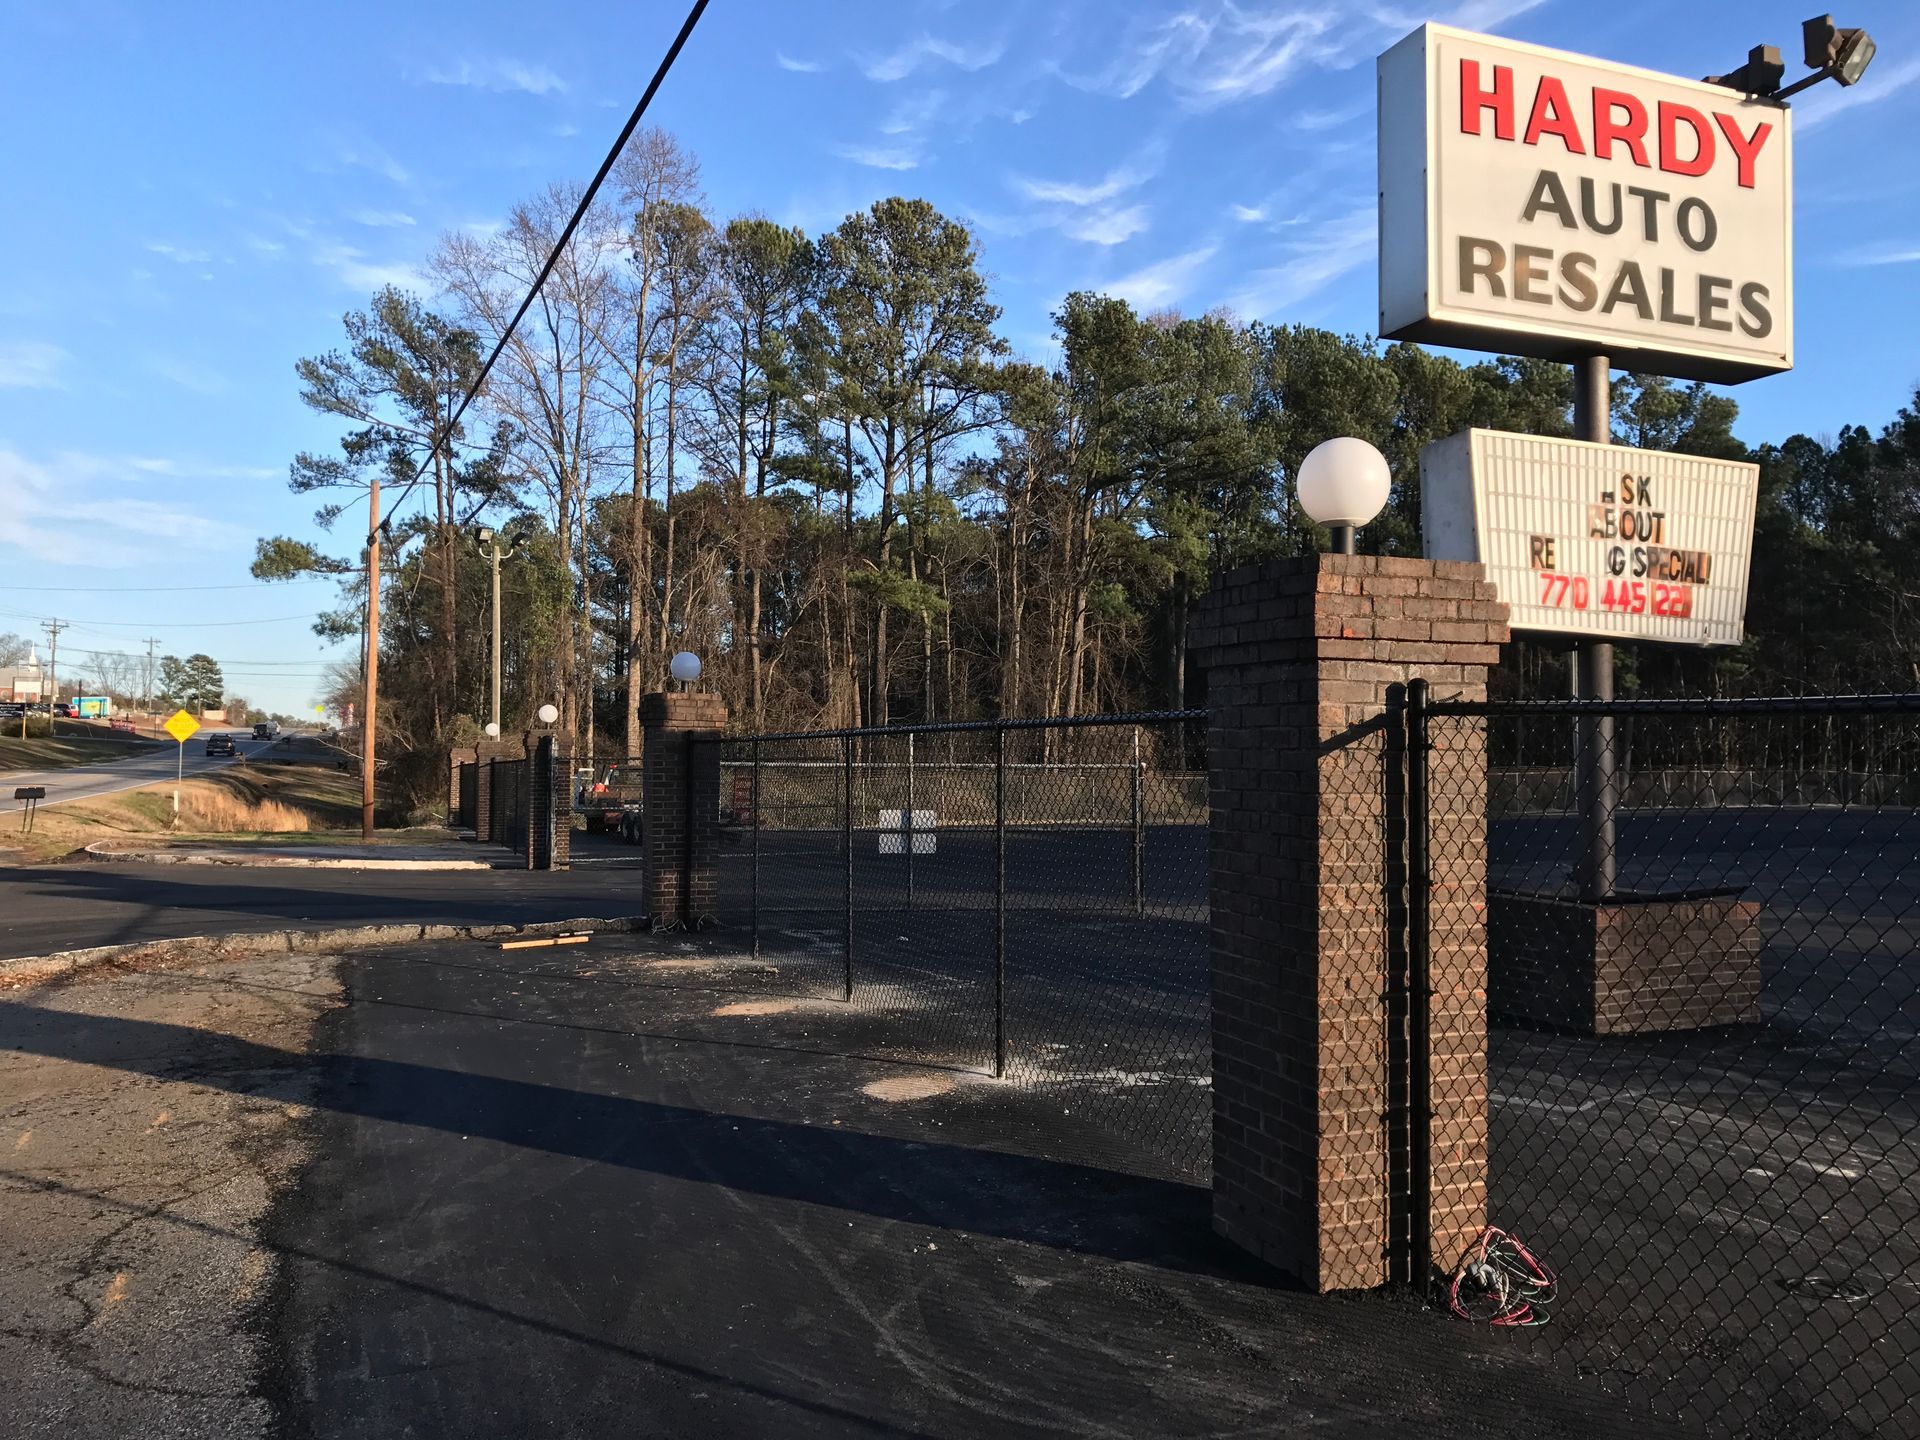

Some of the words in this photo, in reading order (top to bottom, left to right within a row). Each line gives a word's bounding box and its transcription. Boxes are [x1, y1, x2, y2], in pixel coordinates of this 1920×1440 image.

[1459, 58, 1773, 188] HARDY
[1521, 169, 1718, 252] AUTO
[1458, 236, 1773, 339] RESALES
[1541, 573, 1589, 611] 770
[1600, 579, 1647, 614] 445
